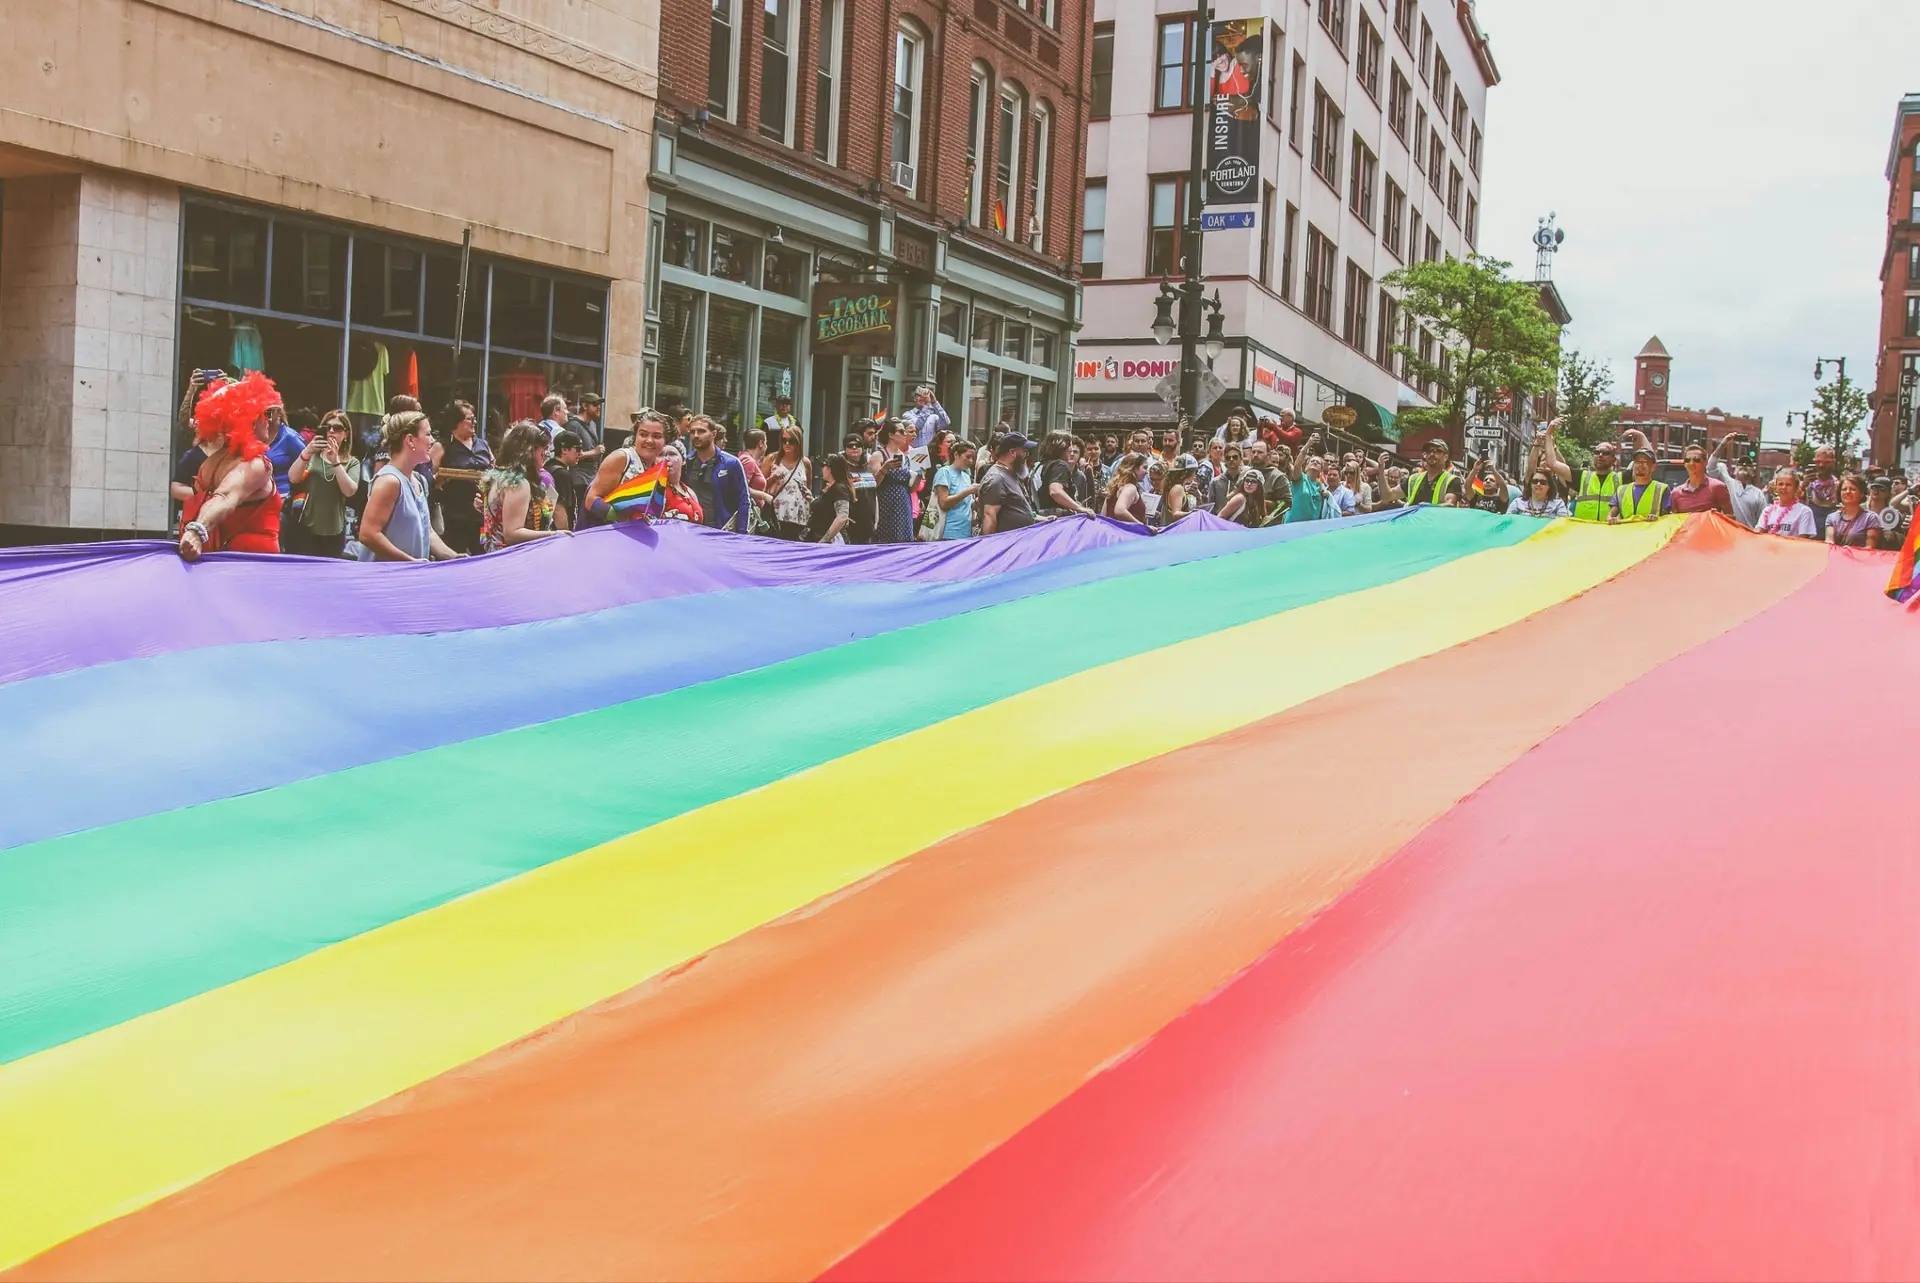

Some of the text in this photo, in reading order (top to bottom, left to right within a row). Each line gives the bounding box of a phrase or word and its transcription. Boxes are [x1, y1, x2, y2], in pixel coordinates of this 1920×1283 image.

[1215, 93, 1234, 150] INSPIRE
[1210, 165, 1256, 181] PORTLAND
[1207, 215, 1226, 227] OAK
[828, 294, 879, 319] TACO
[817, 308, 889, 340] ESCOBARR
[1075, 360, 1179, 378] IN' DONU
[1899, 375, 1911, 439] EMPIRE
